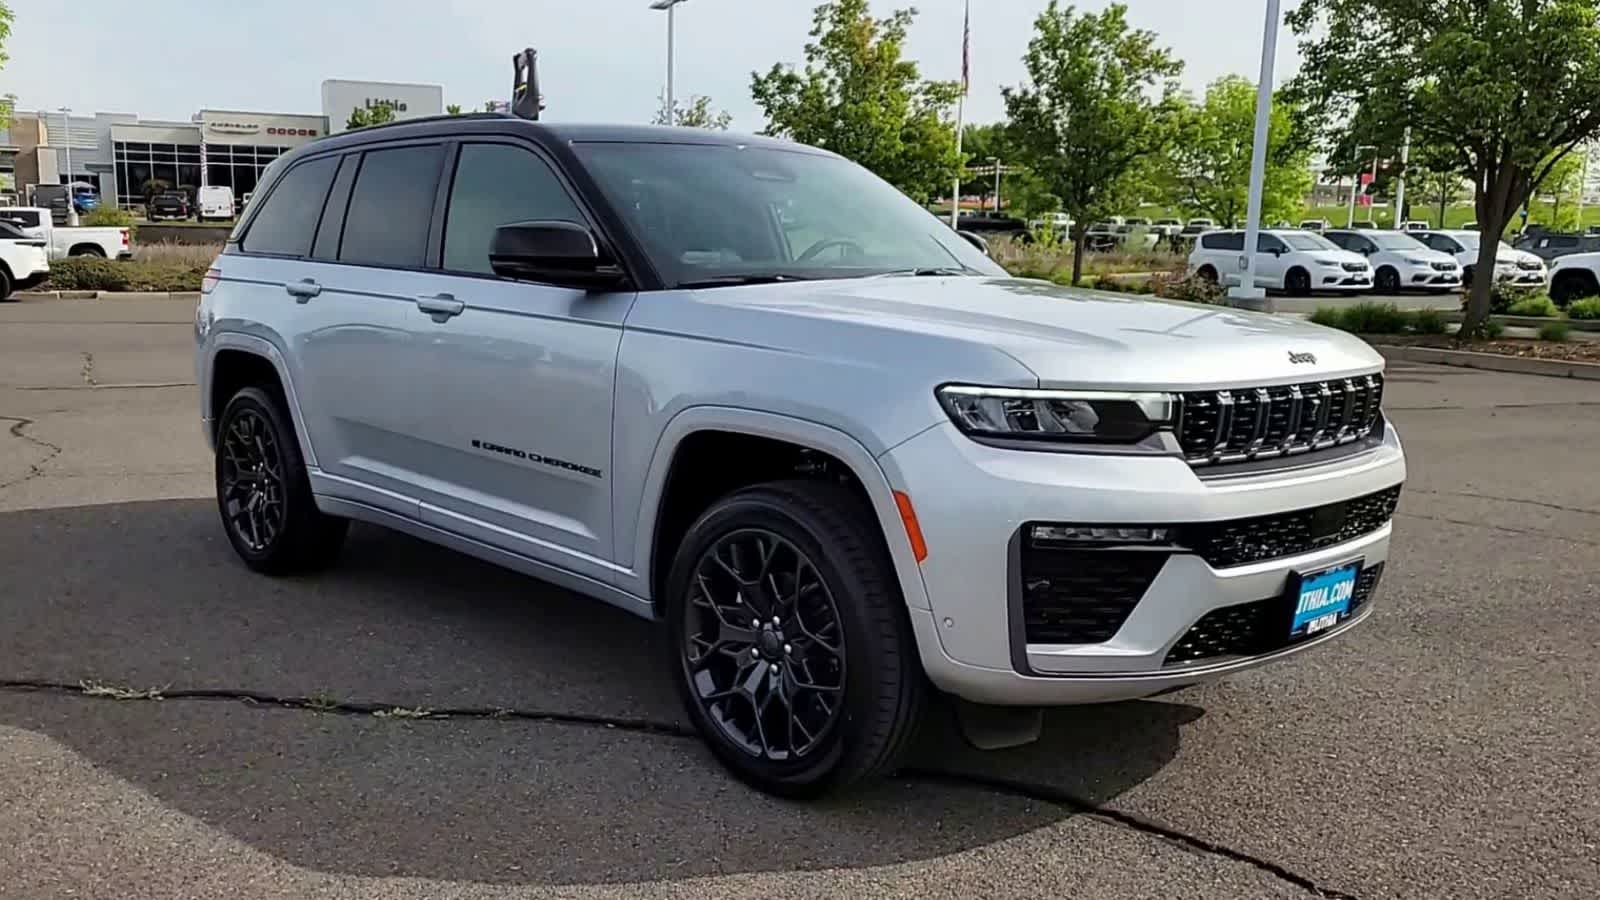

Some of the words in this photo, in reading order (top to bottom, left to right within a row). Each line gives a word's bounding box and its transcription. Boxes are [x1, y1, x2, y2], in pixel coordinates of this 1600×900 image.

[1288, 351, 1317, 365] Jeep
[482, 442, 526, 459] GRAND
[529, 453, 602, 478] CHEROKEE
